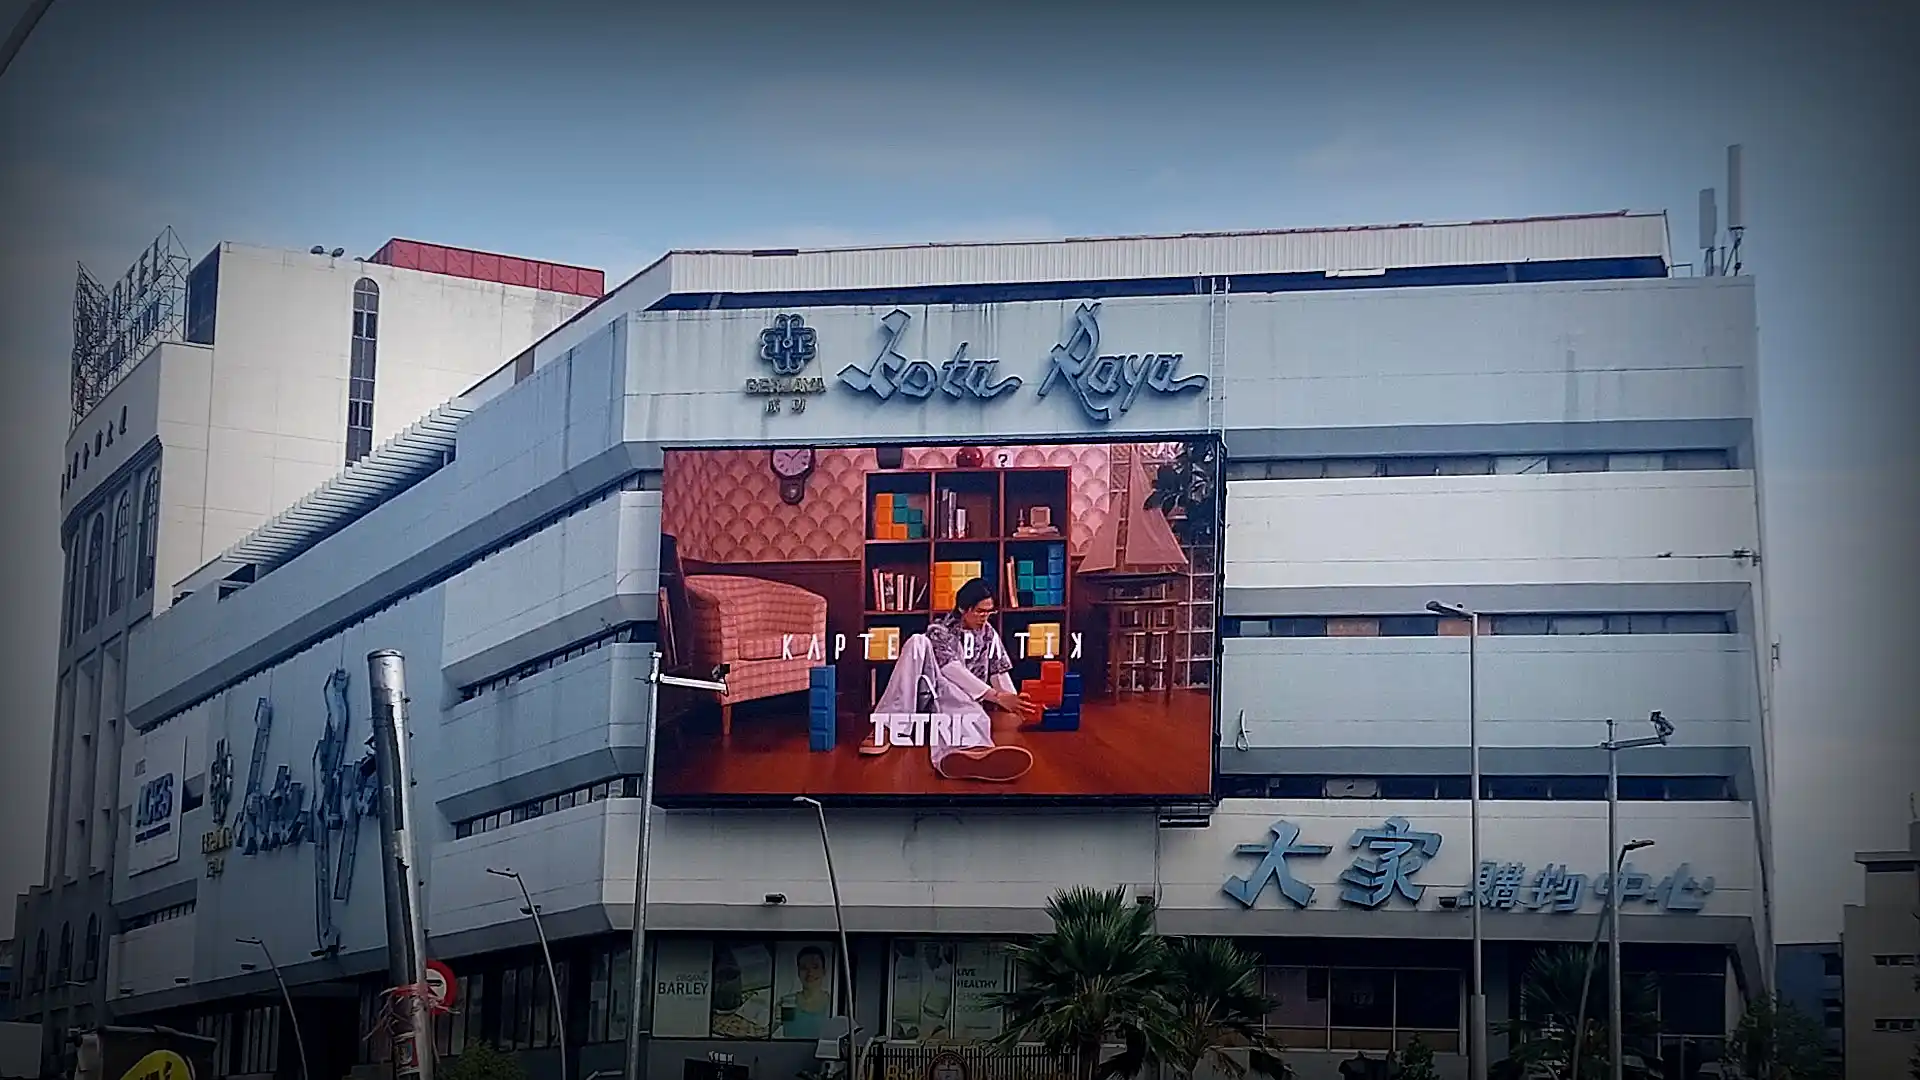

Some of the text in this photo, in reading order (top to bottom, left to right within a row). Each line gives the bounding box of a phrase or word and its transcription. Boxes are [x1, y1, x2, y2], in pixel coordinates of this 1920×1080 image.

[838, 303, 1208, 421] Kota Raya
[781, 632, 1084, 661] KAPTEN BATIK
[869, 713, 981, 747] TETRIS
[1224, 816, 1714, 913] 大家 購物中心
[658, 982, 708, 995] BARLEY
[957, 979, 997, 988] HEALTHY
